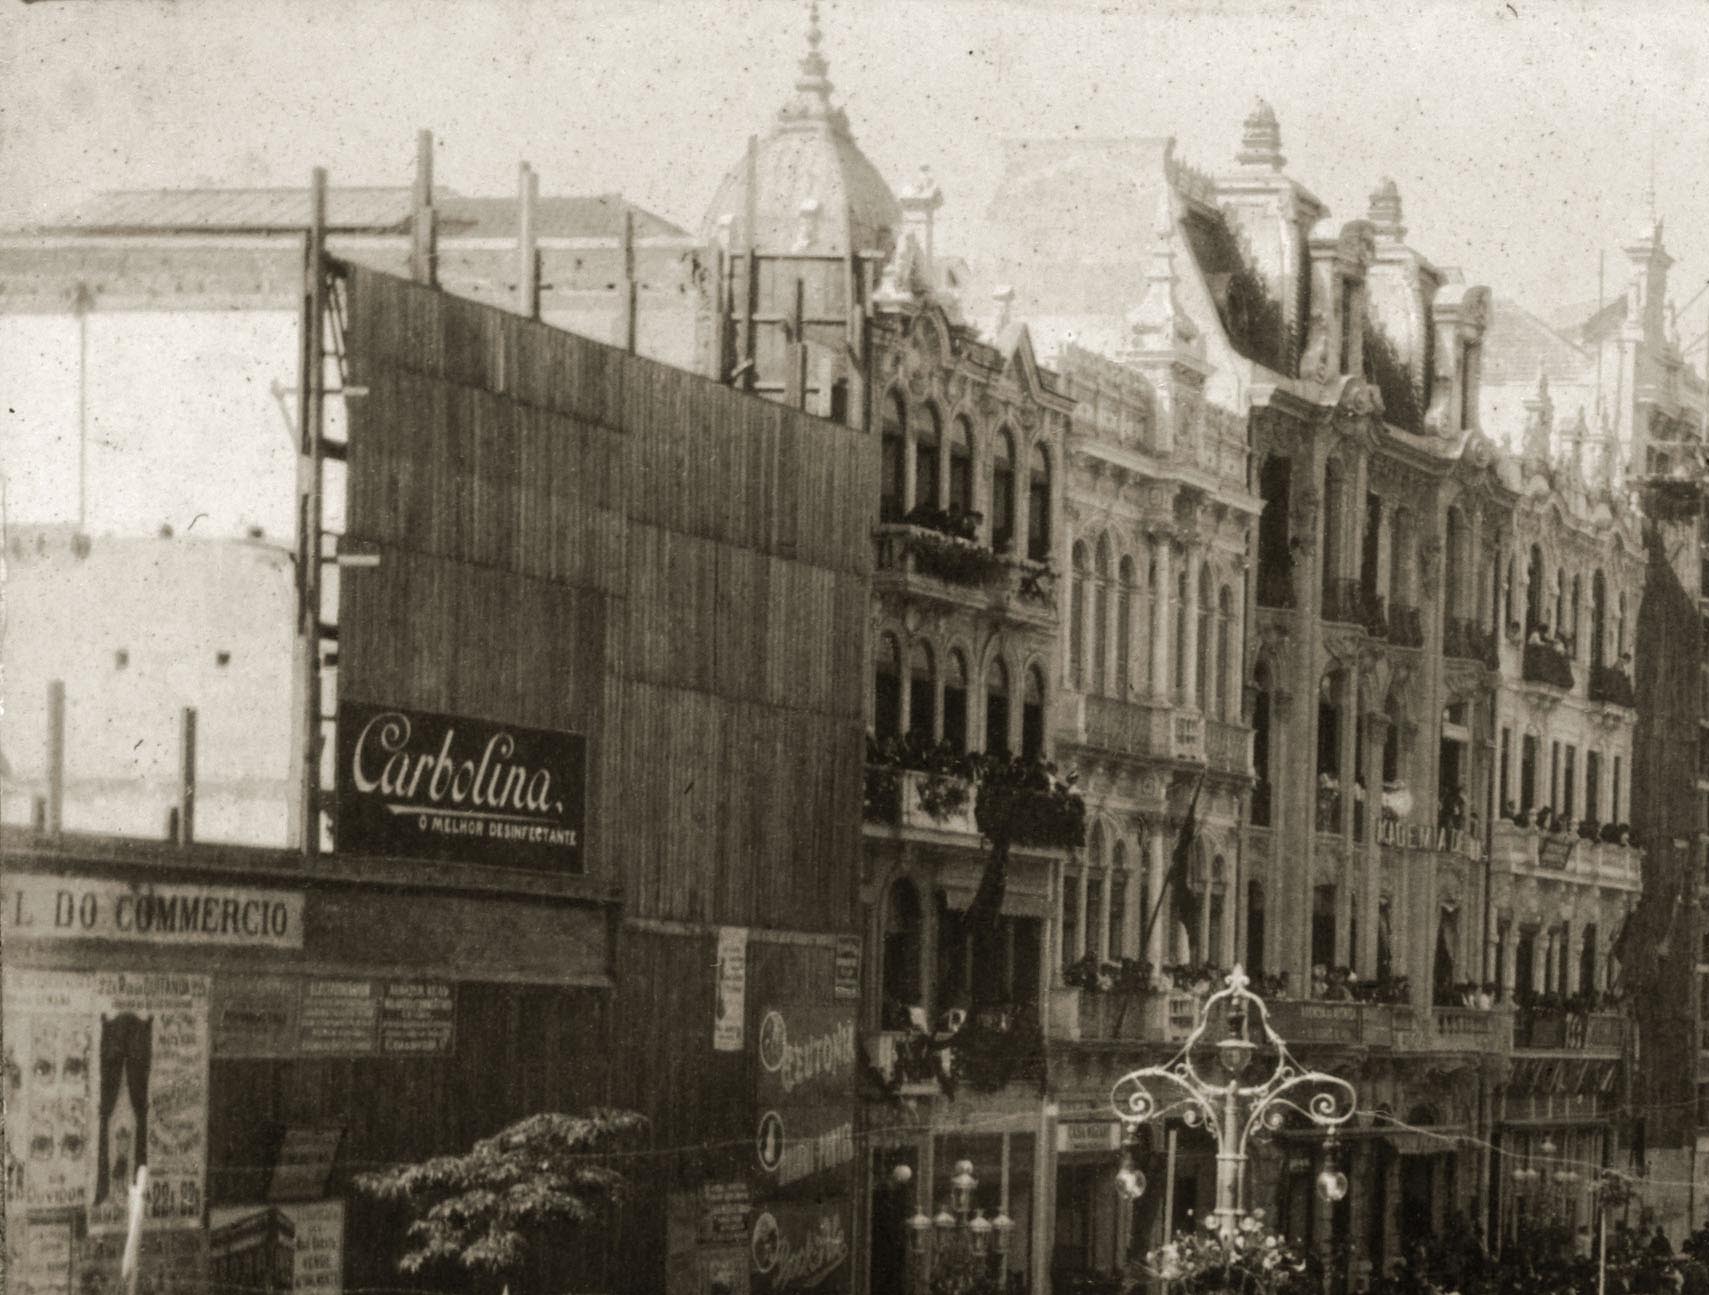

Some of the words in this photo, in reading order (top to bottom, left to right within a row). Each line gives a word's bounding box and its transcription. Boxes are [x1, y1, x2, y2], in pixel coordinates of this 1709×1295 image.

[431, 816, 485, 837] MELHOR
[488, 820, 578, 847] DESINFECTANTE
[54, 888, 99, 931] DO
[115, 892, 288, 938] COMMERCIO
